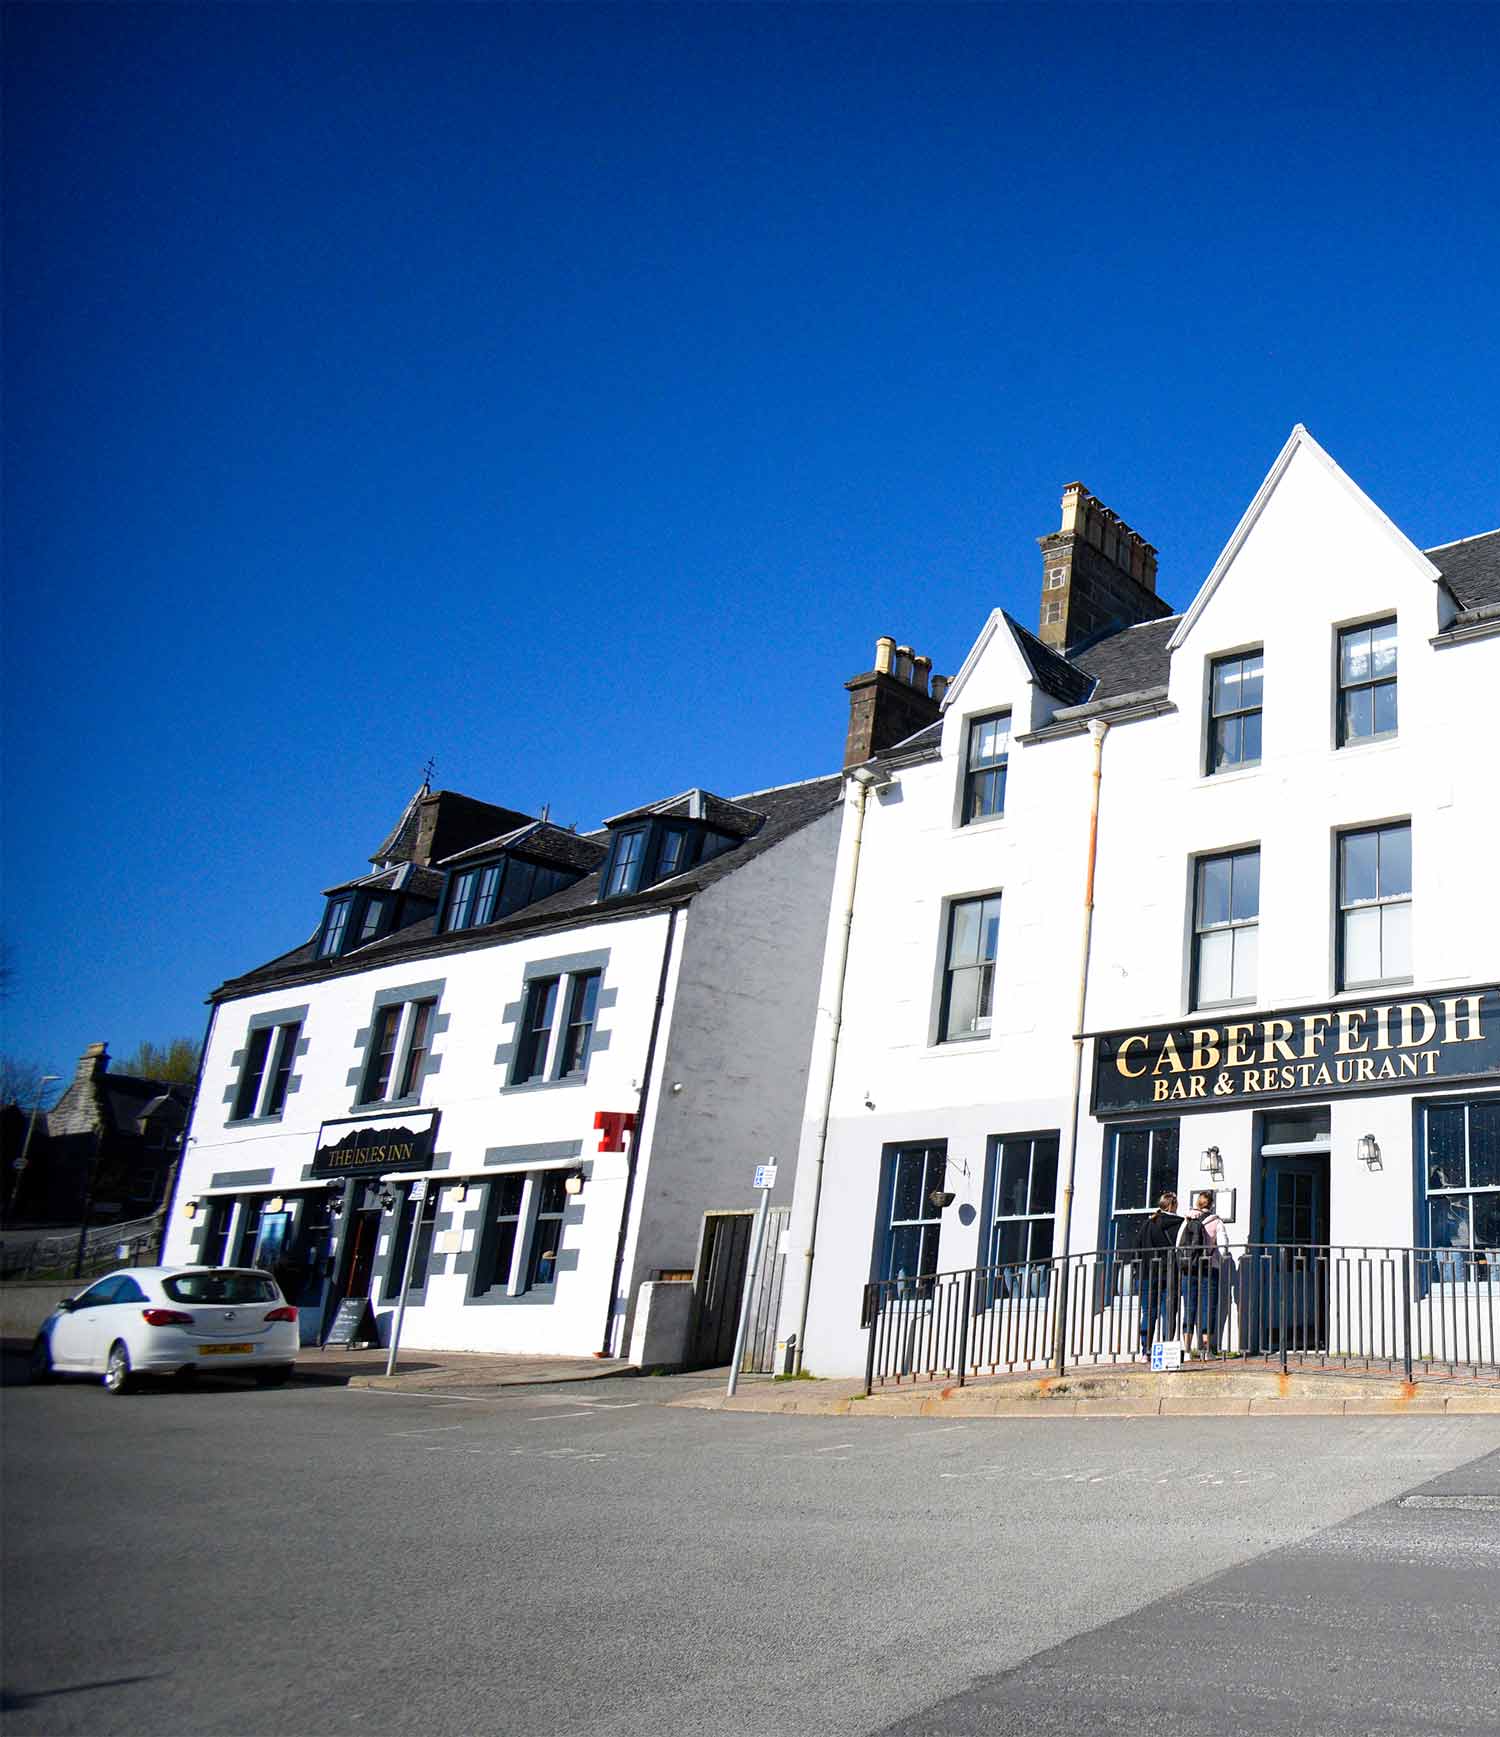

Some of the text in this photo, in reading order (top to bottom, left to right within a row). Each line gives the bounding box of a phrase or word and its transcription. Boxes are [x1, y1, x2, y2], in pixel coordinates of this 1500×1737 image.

[1115, 995, 1486, 1078] CABERFEIDH
[1152, 1049, 1441, 1102] BAR & RESTAURANT
[328, 1143, 414, 1167] THE ISLES INN
